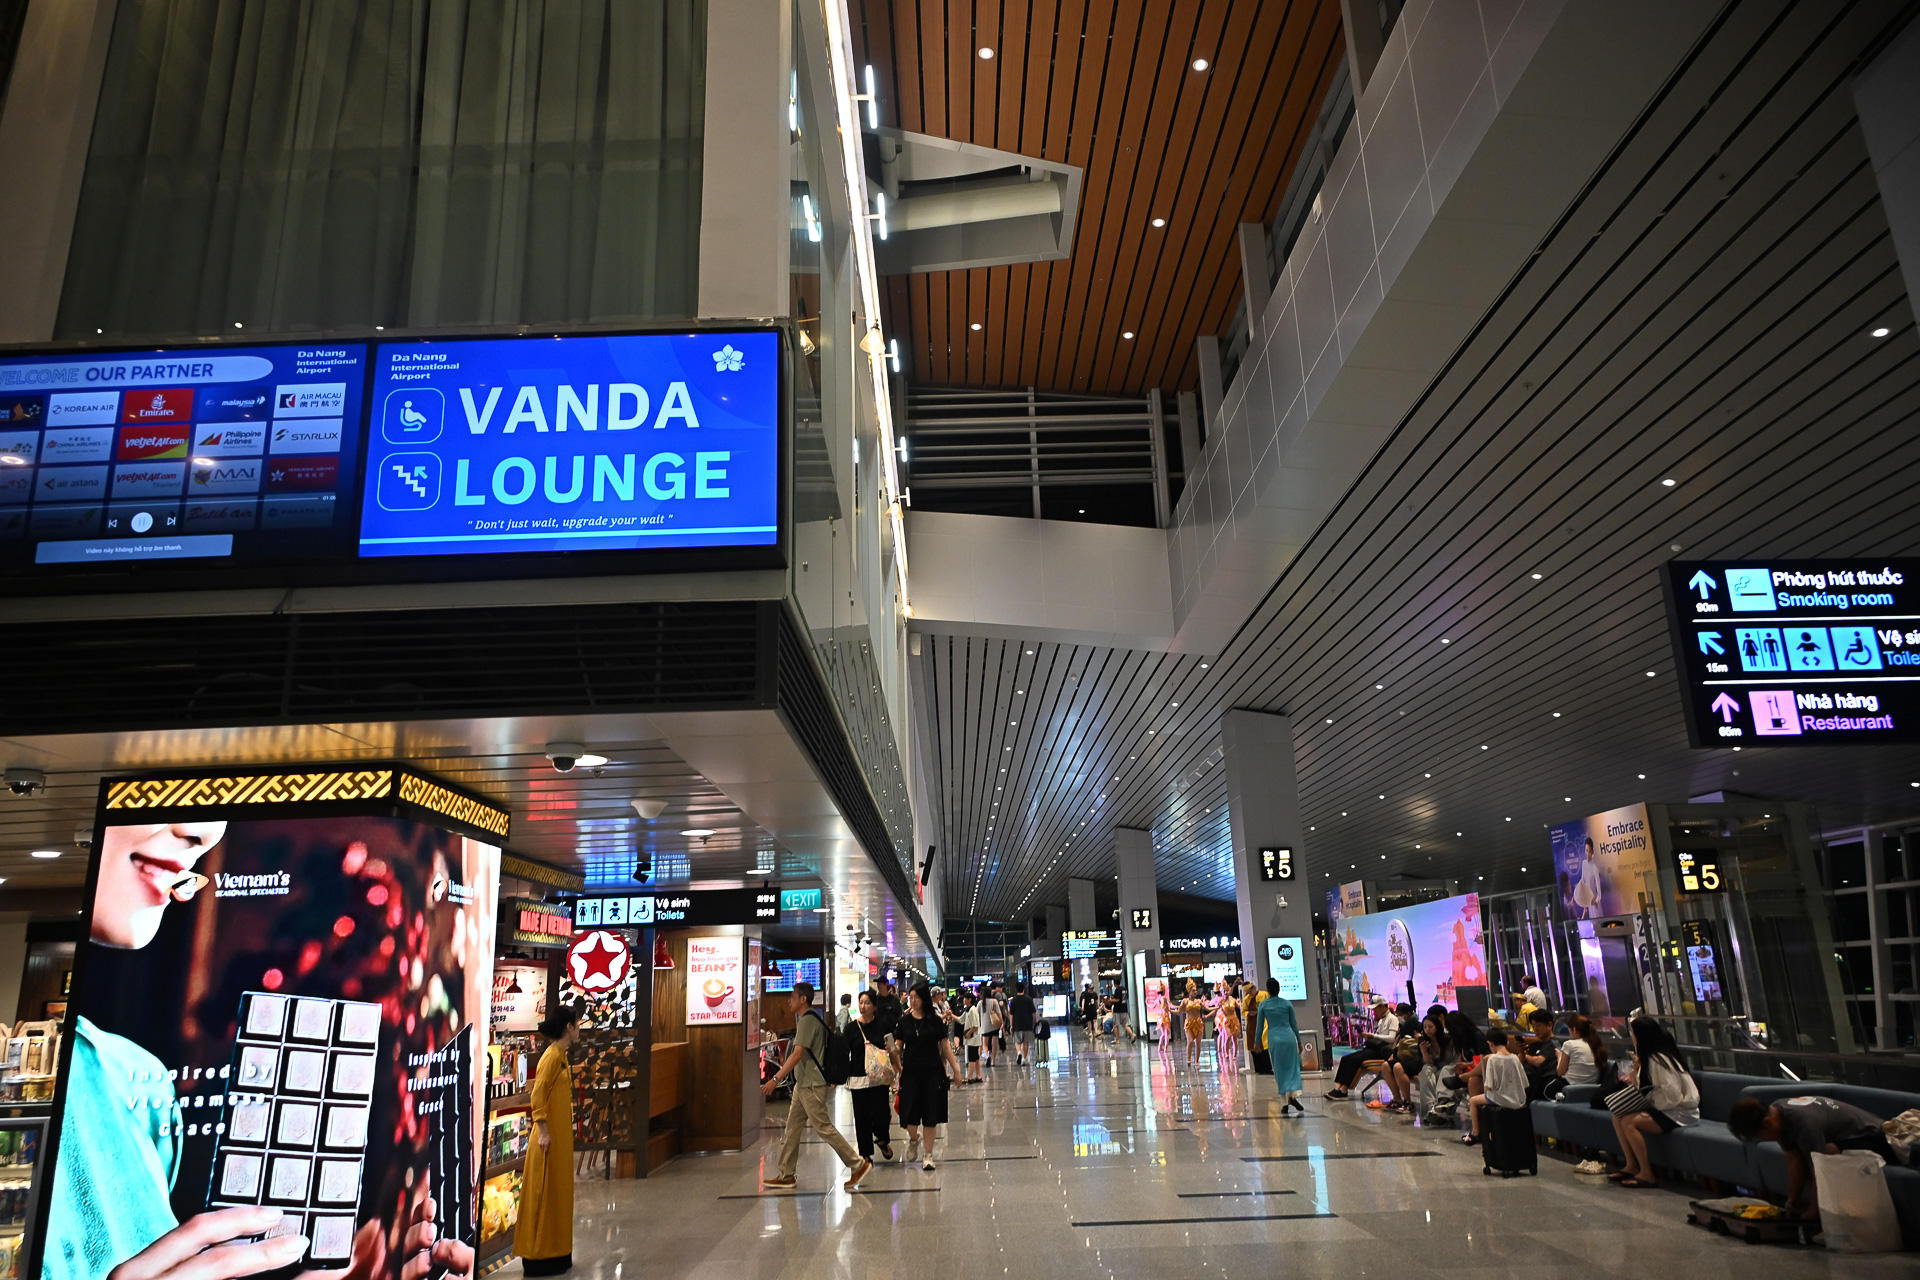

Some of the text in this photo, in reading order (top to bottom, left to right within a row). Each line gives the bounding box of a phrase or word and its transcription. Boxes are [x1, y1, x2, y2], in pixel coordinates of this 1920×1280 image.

[298, 350, 346, 359] Da Nang
[392, 353, 447, 362] Da Nang
[296, 358, 357, 367] International
[391, 363, 460, 372] International
[85, 366, 127, 382] OUR
[131, 363, 214, 380] PARTNER
[296, 367, 332, 375] Airport
[390, 373, 431, 381] Airport
[139, 408, 175, 417] Emirates
[459, 381, 700, 435] VANDA
[225, 430, 262, 438] Philippine
[291, 432, 338, 441] STARLUX
[214, 467, 256, 480] MAI
[454, 451, 731, 507] LOUNGE
[57, 479, 99, 488] air astana
[475, 519, 505, 530] Don't
[505, 519, 528, 531] just
[532, 518, 559, 529] wait,
[562, 516, 607, 529] upgrade
[609, 517, 637, 528] your
[640, 515, 665, 525] wait
[1772, 567, 1903, 590] Phòng hút thuốc
[1778, 592, 1894, 610] Smoking room
[1878, 629, 1920, 647] Vệ si
[1882, 650, 1920, 666] Toile
[1706, 662, 1729, 673] 15m
[1797, 692, 1879, 711] Nhà hàng
[1802, 714, 1894, 731] Restaurant
[1607, 819, 1644, 837] Embrace
[1600, 834, 1647, 855] Hospitality
[1278, 859, 1291, 878] 5
[214, 870, 290, 889] Vietnam's
[1702, 864, 1720, 890] 5
[671, 897, 690, 908] sinh
[792, 892, 817, 907] EXIT
[656, 910, 685, 921] Toilets
[1141, 915, 1150, 928] 4
[520, 910, 572, 937] MADE IN VIETNAM
[1169, 938, 1207, 949] KITCHEN
[1693, 931, 1701, 945] 5
[691, 963, 737, 973] BEAN?
[690, 1011, 738, 1020] STAR CAFE
[408, 1049, 460, 1068] Inspired by
[128, 1063, 271, 1082] Inspired by
[407, 1073, 458, 1092] Vietnamese
[127, 1093, 266, 1110] Vietnamese
[418, 1099, 444, 1116] Grace
[159, 1122, 226, 1137] Grace
